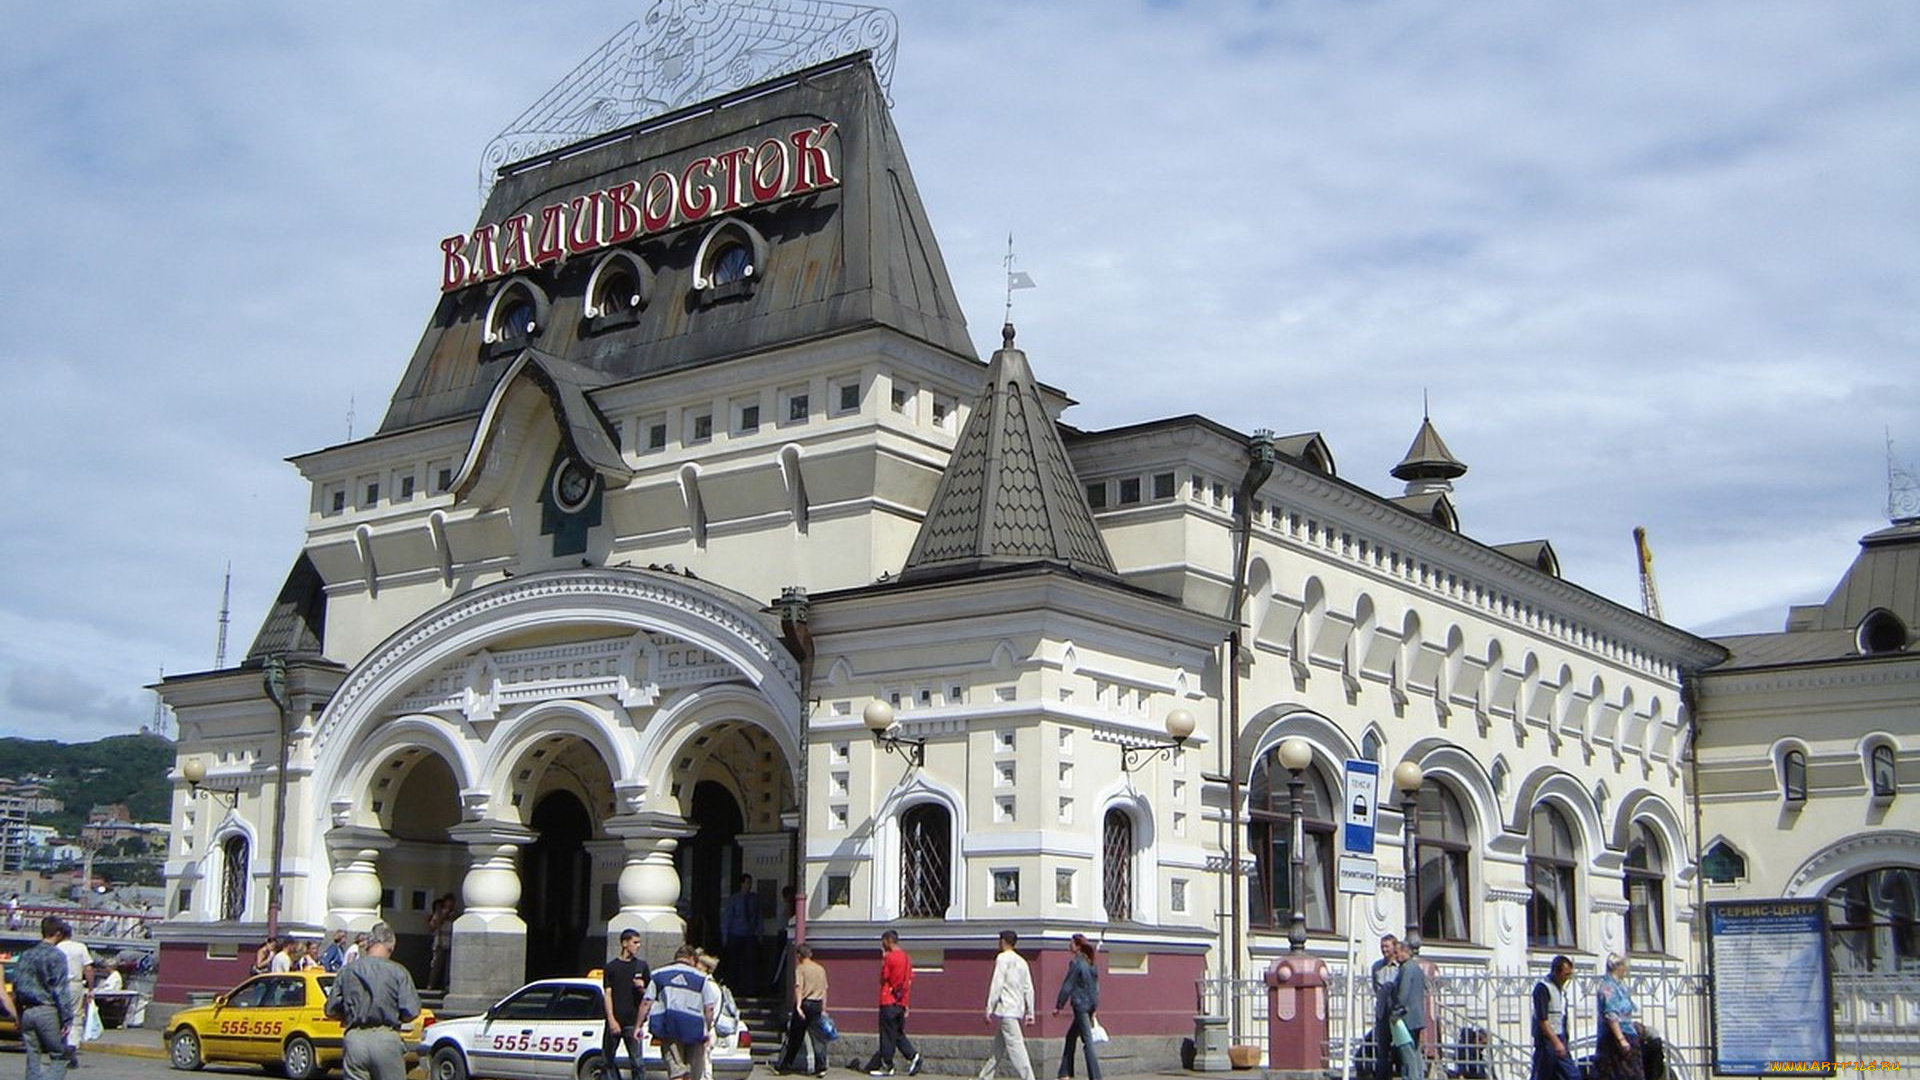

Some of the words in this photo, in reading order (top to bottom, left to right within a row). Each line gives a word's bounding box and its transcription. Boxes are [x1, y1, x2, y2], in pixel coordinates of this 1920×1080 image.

[440, 121, 839, 291] ВЛАДИВОСТОК
[1717, 903, 1817, 917] СЕРВИС-ЦЕНТР
[221, 1020, 282, 1035] 555-555
[493, 1035, 579, 1052] 555-555
